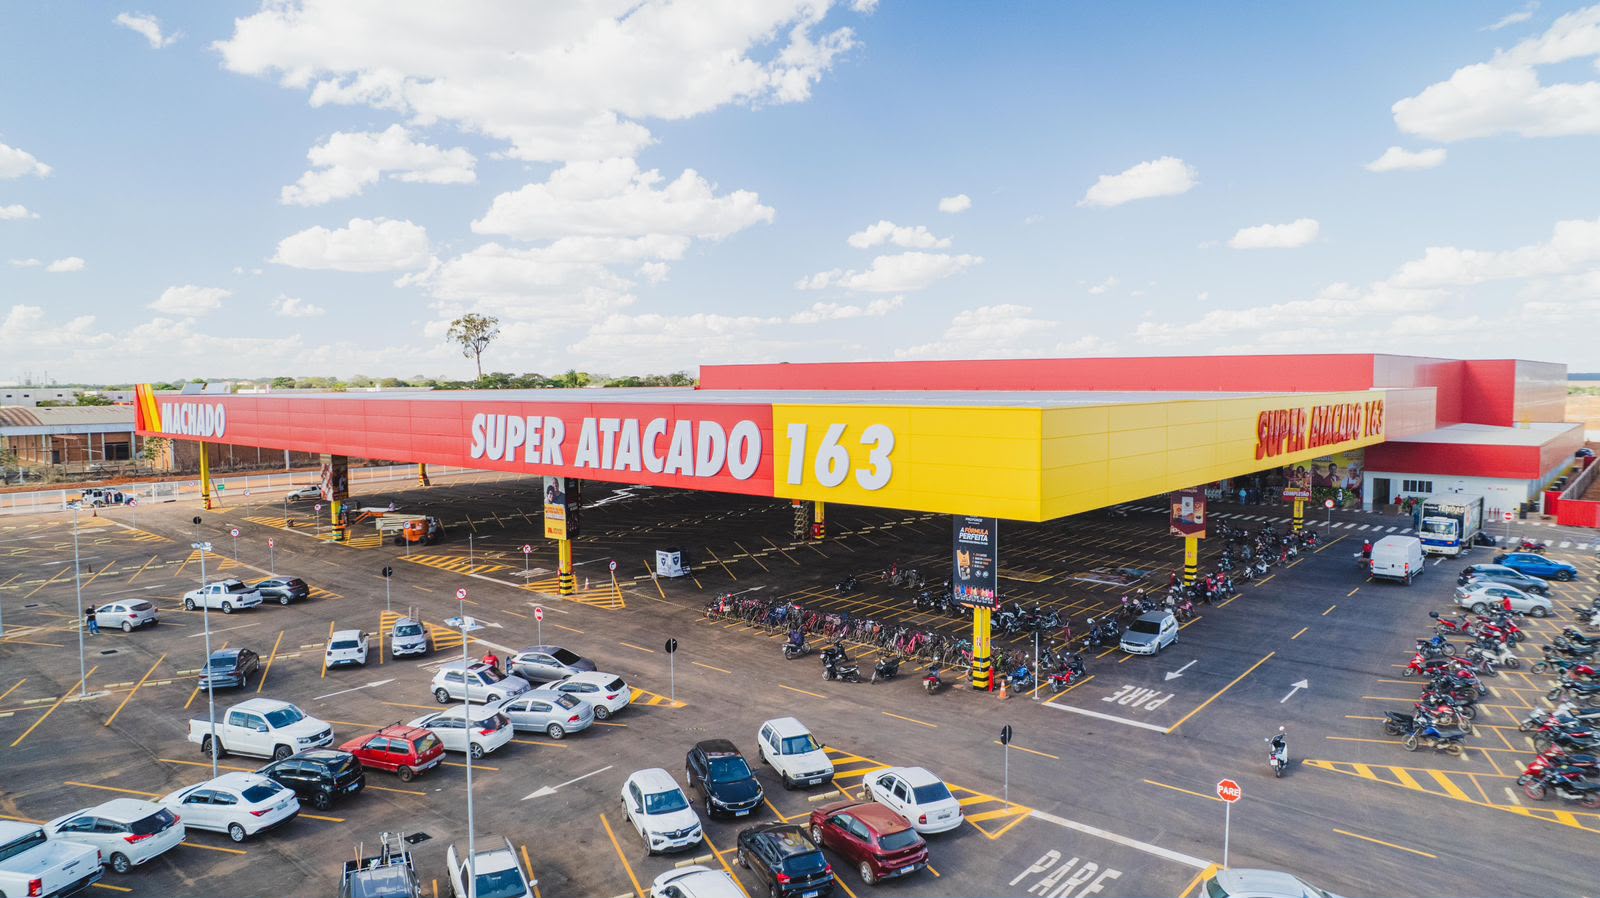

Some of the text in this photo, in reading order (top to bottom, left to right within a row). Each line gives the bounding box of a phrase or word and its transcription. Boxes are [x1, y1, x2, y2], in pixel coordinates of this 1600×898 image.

[162, 402, 226, 438] MACHADO
[1255, 399, 1384, 460] SUPER ATACADO 163
[470, 413, 896, 491] SUPER ATACADO 163
[959, 532, 988, 541] PERFEITA
[965, 526, 988, 535] FÓRMULA
[1101, 684, 1176, 711] PARE
[1217, 785, 1240, 797] PARE
[1008, 849, 1123, 898] PARE
